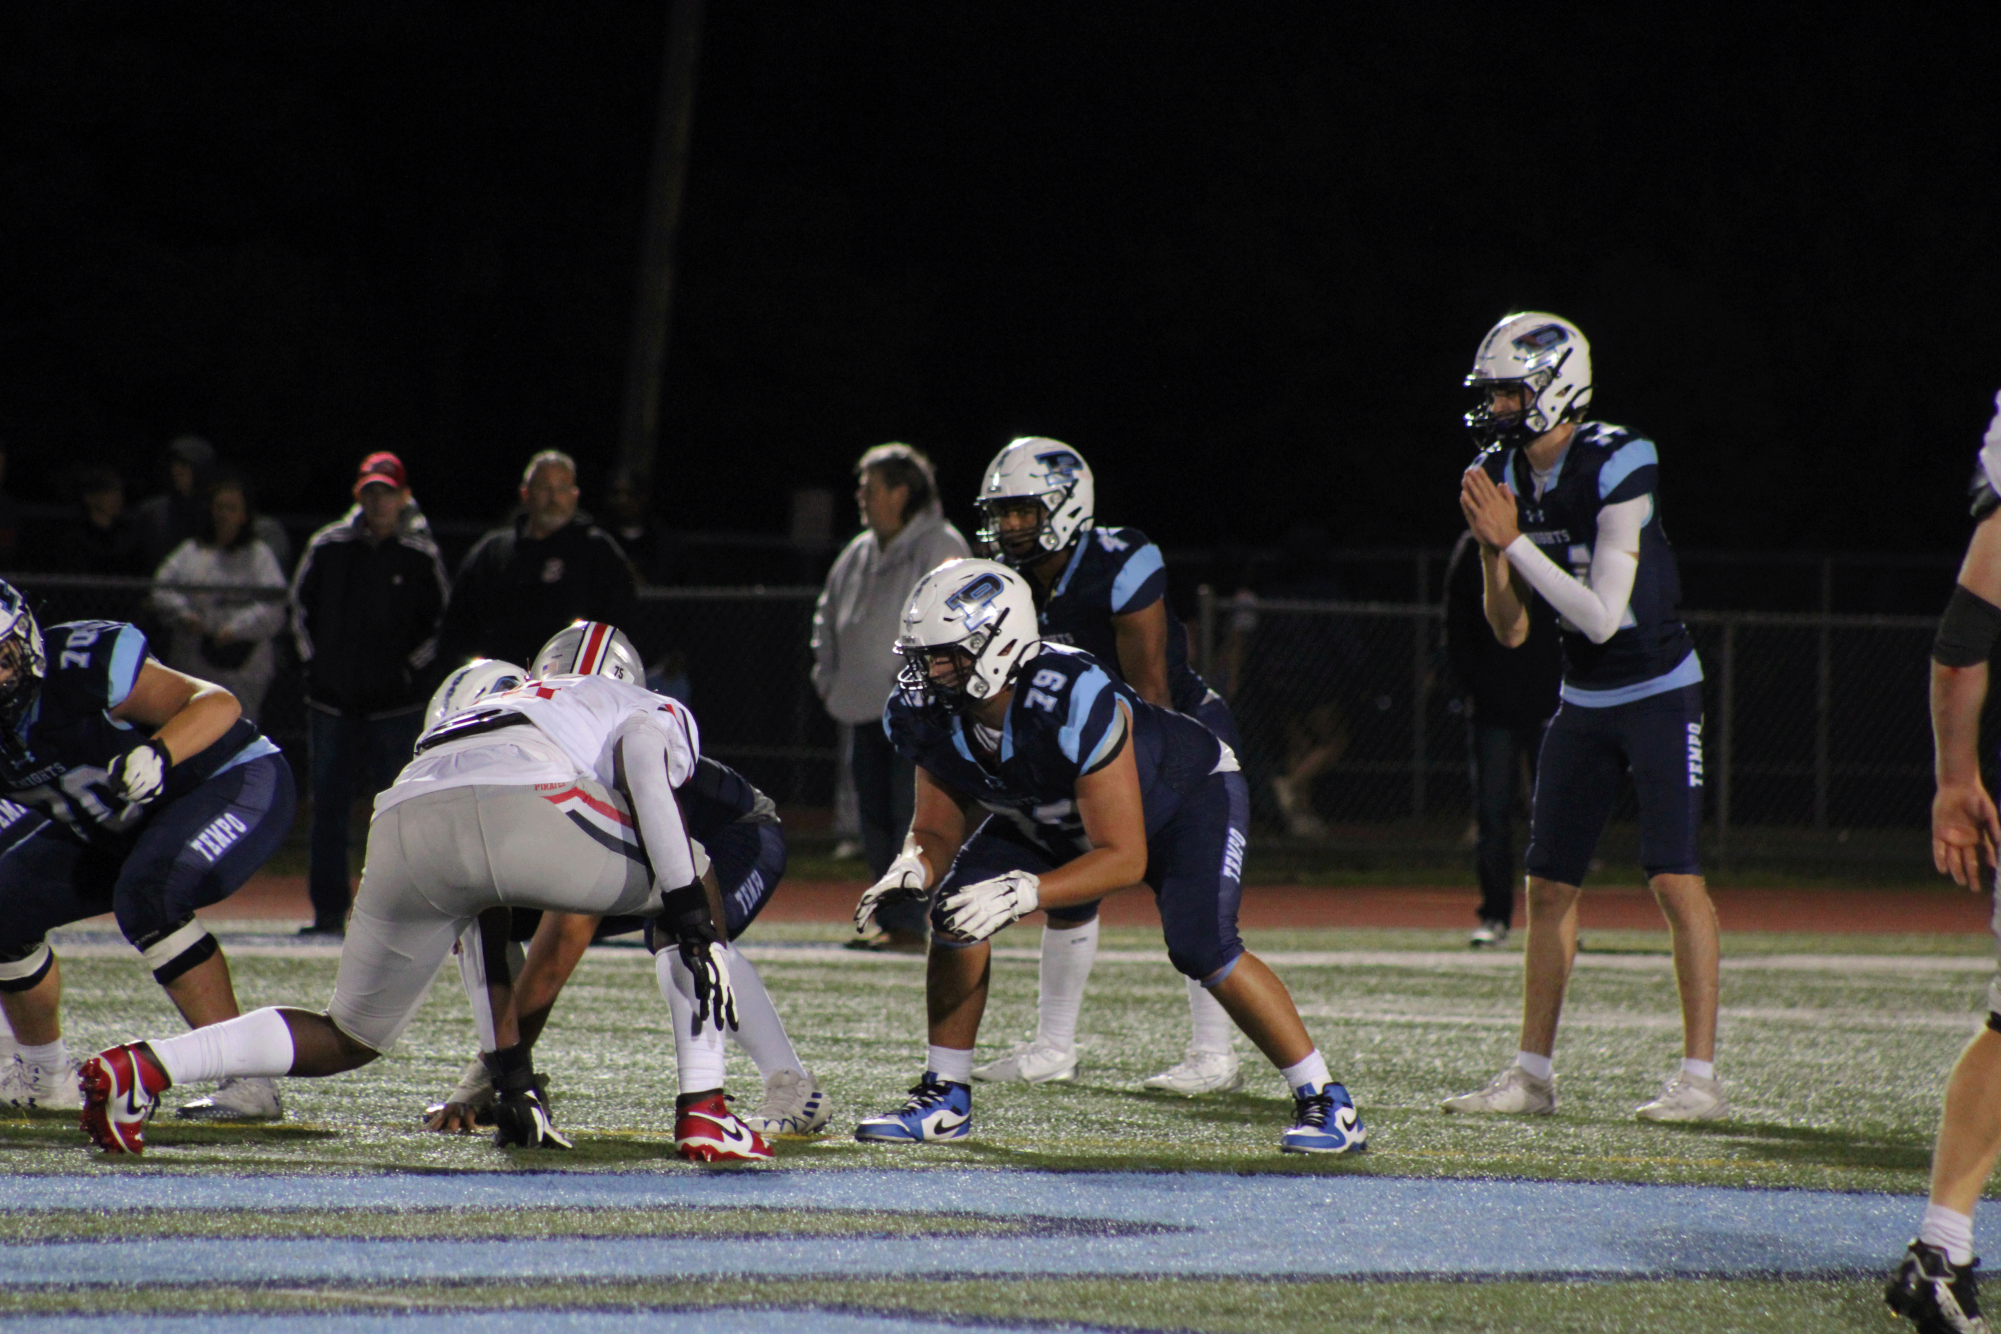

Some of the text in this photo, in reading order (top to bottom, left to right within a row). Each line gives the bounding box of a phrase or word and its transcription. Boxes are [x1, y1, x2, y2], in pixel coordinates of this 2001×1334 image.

[944, 572, 1005, 632] P
[60, 624, 99, 670] 70
[614, 665, 624, 680] 75
[1023, 668, 1068, 713] 79
[1686, 722, 1704, 787] TEMPO
[190, 812, 248, 862] TEMPO
[1223, 827, 1247, 885] TEMPO
